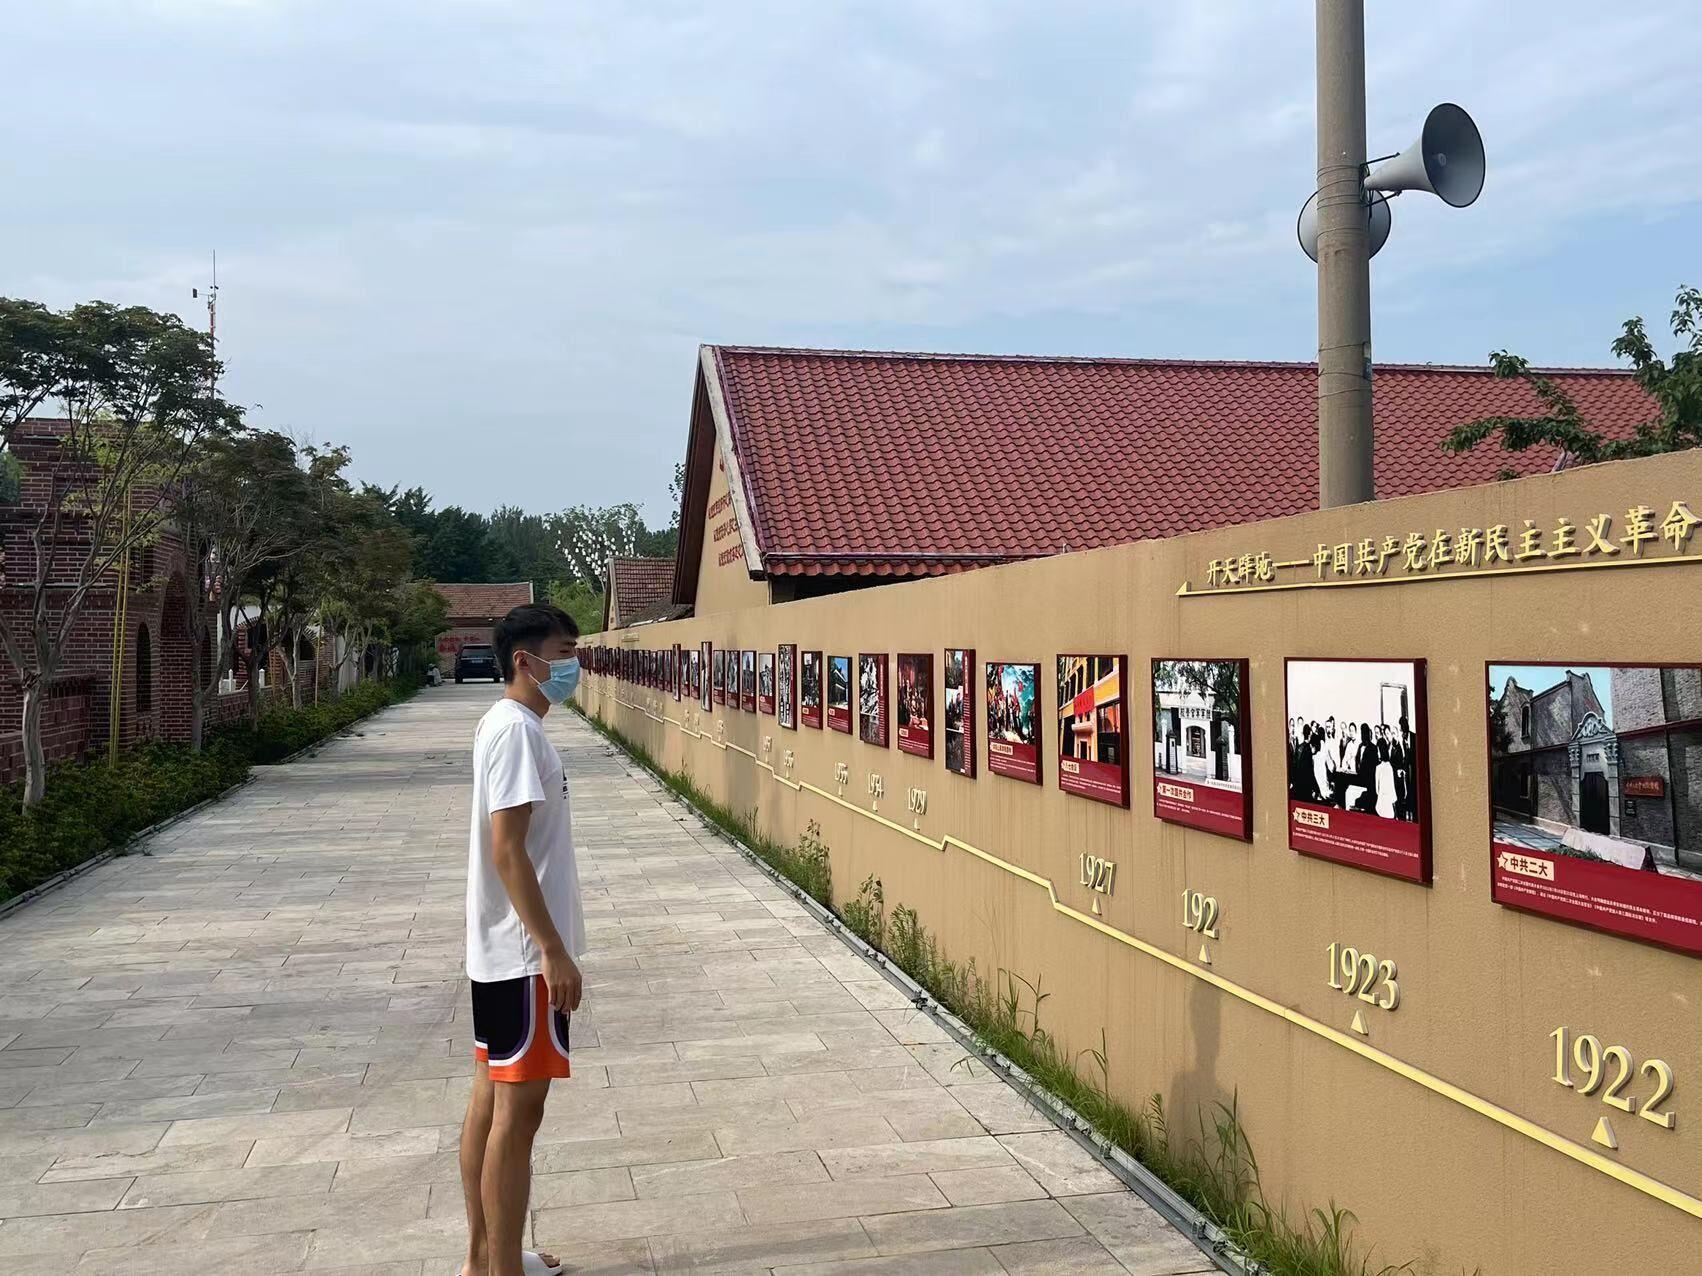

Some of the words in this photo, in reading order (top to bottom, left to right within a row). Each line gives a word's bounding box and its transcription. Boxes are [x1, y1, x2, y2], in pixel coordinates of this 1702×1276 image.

[1301, 811, 1325, 826] 中共三大
[1079, 852, 1116, 896] 1927
[1509, 856, 1548, 877] 中共二大
[1181, 888, 1219, 939] 192
[1326, 942, 1399, 1011] 1923
[1549, 1026, 1675, 1130] 1922
